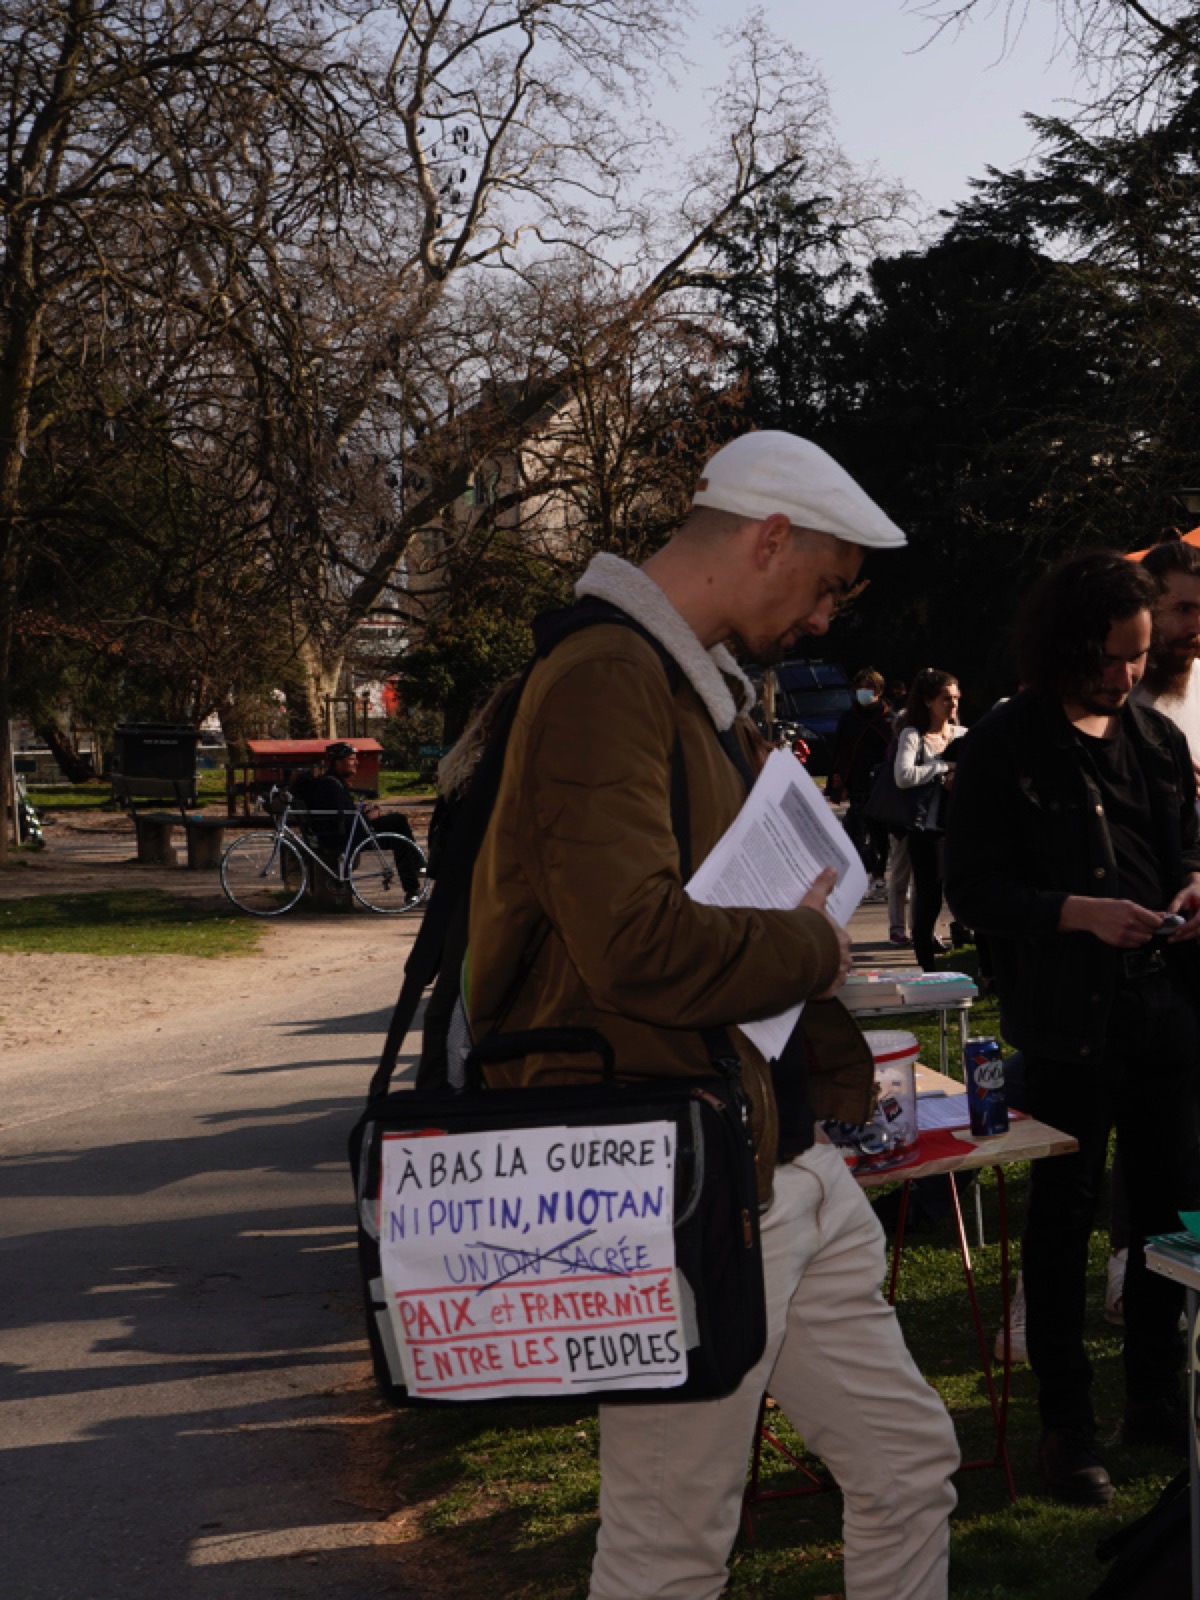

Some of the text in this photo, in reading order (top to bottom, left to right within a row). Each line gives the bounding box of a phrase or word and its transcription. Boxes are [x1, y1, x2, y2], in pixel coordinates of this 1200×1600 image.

[429, 1149, 483, 1188] BAS
[494, 1141, 528, 1178] LA
[546, 1138, 656, 1172] GUERRE
[389, 1203, 419, 1242] NI
[428, 1196, 531, 1235] PUTIN,
[443, 1248, 541, 1284] UNION
[398, 1296, 476, 1337] PAIX
[489, 1292, 515, 1325] et
[412, 1329, 682, 1382] ENTRE LES PEUPLES
